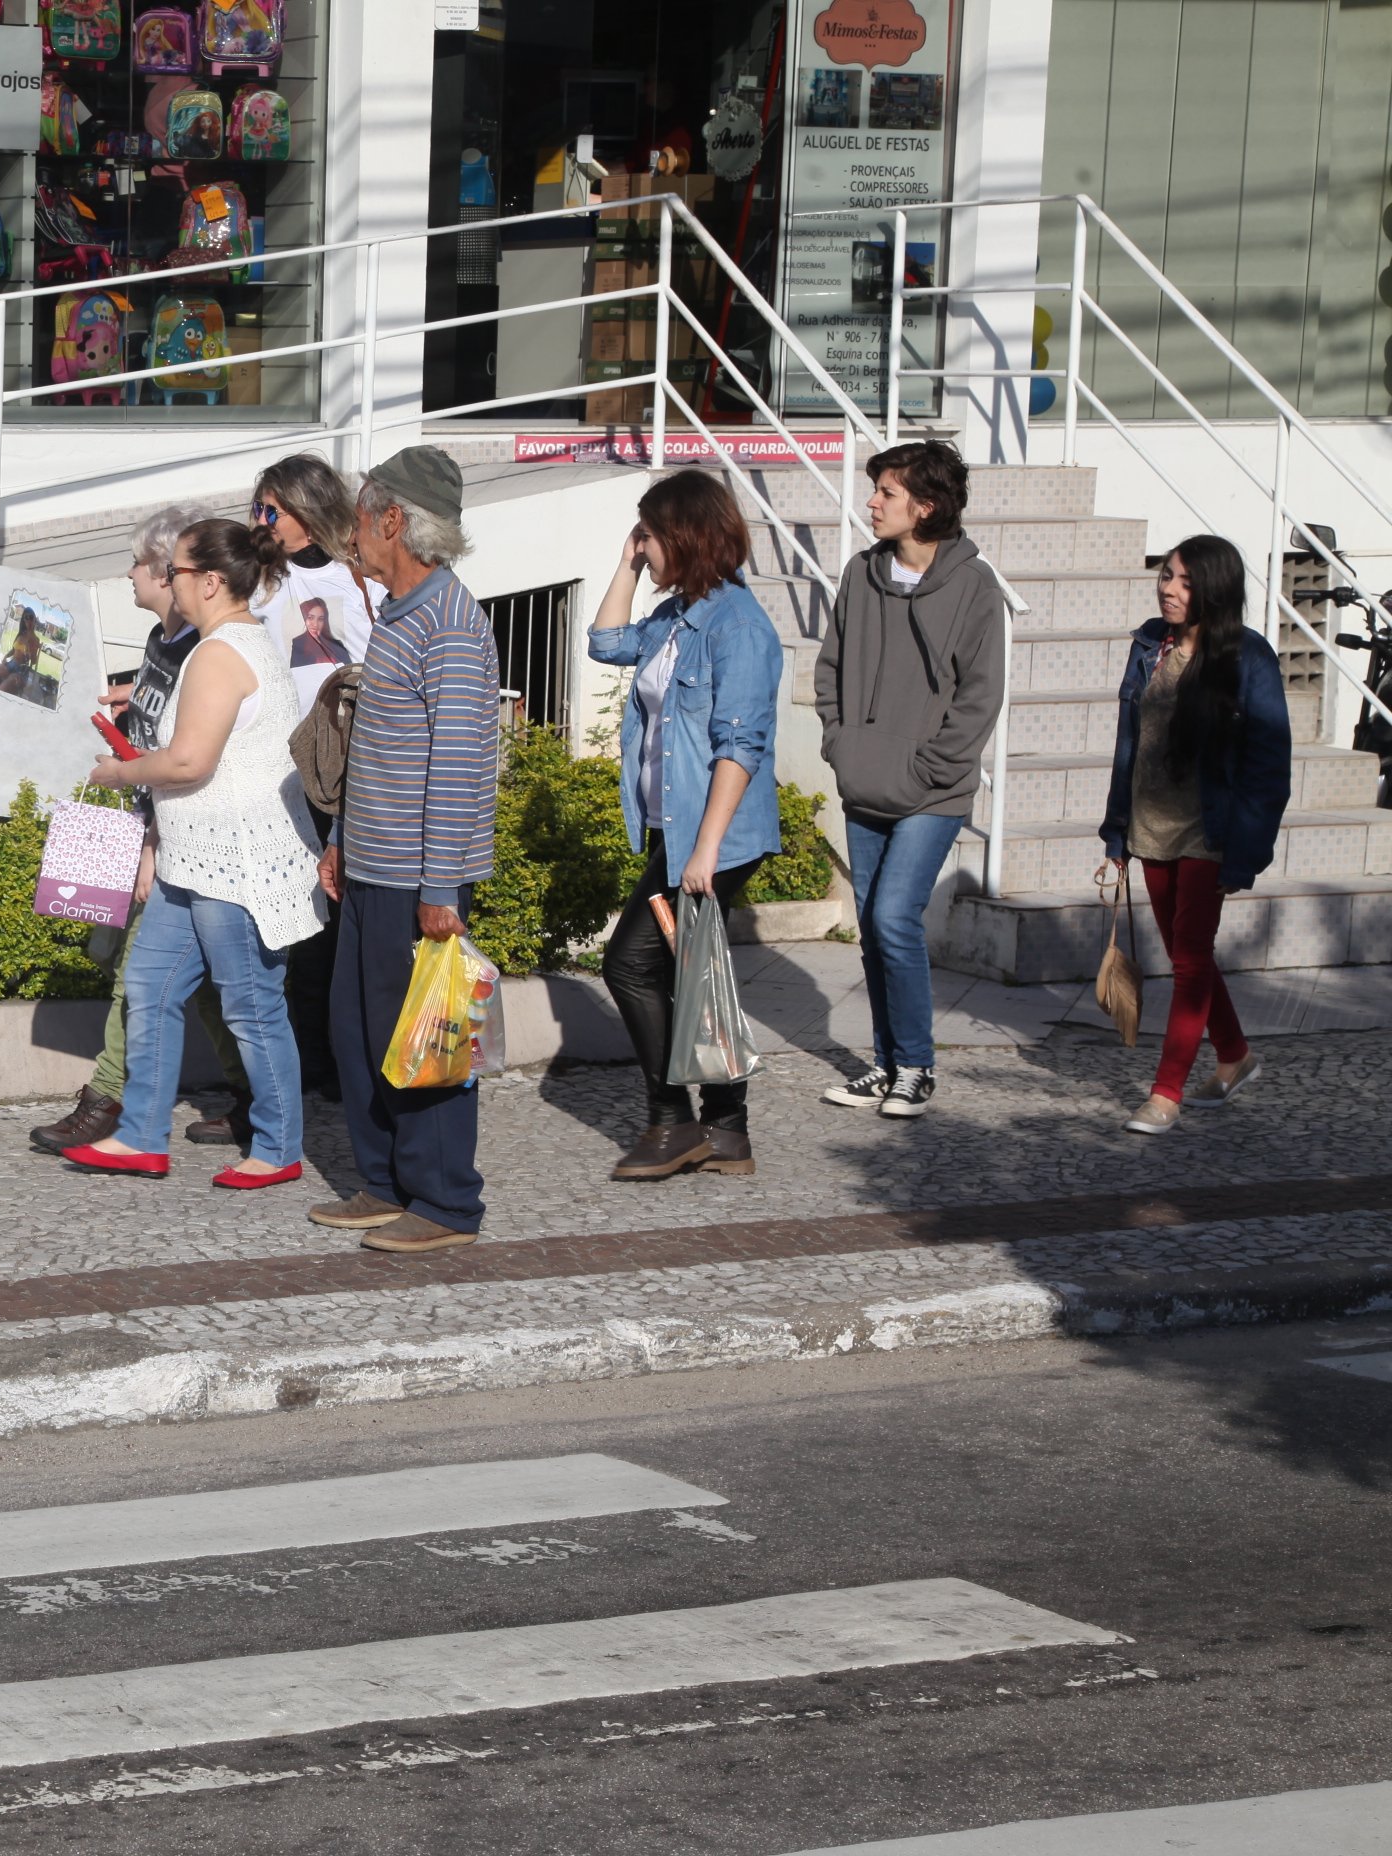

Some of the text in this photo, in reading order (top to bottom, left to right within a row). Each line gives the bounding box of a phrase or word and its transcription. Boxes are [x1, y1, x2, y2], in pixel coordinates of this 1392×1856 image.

[822, 22, 918, 40] Mimos&Festas
[711, 127, 755, 150] Aberto
[803, 135, 930, 151] ALUGUEL DE FESTAS
[851, 165, 915, 179] PROVENÇAIS
[850, 181, 929, 194] COMPRESSORES
[849, 196, 882, 208] SALÃO
[798, 314, 818, 325] Rua
[822, 315, 868, 326] Adhemar
[872, 316, 883, 326] da
[845, 332, 861, 343] 906
[826, 348, 889, 362] Esquina com
[849, 366, 859, 376] Di
[519, 443, 566, 455] FAVOR
[570, 443, 621, 455] DEIXAR
[623, 443, 642, 454] AS
[646, 443, 710, 455] SCOLAS
[739, 442, 795, 454] GUARDA
[49, 900, 113, 923] Clamar
